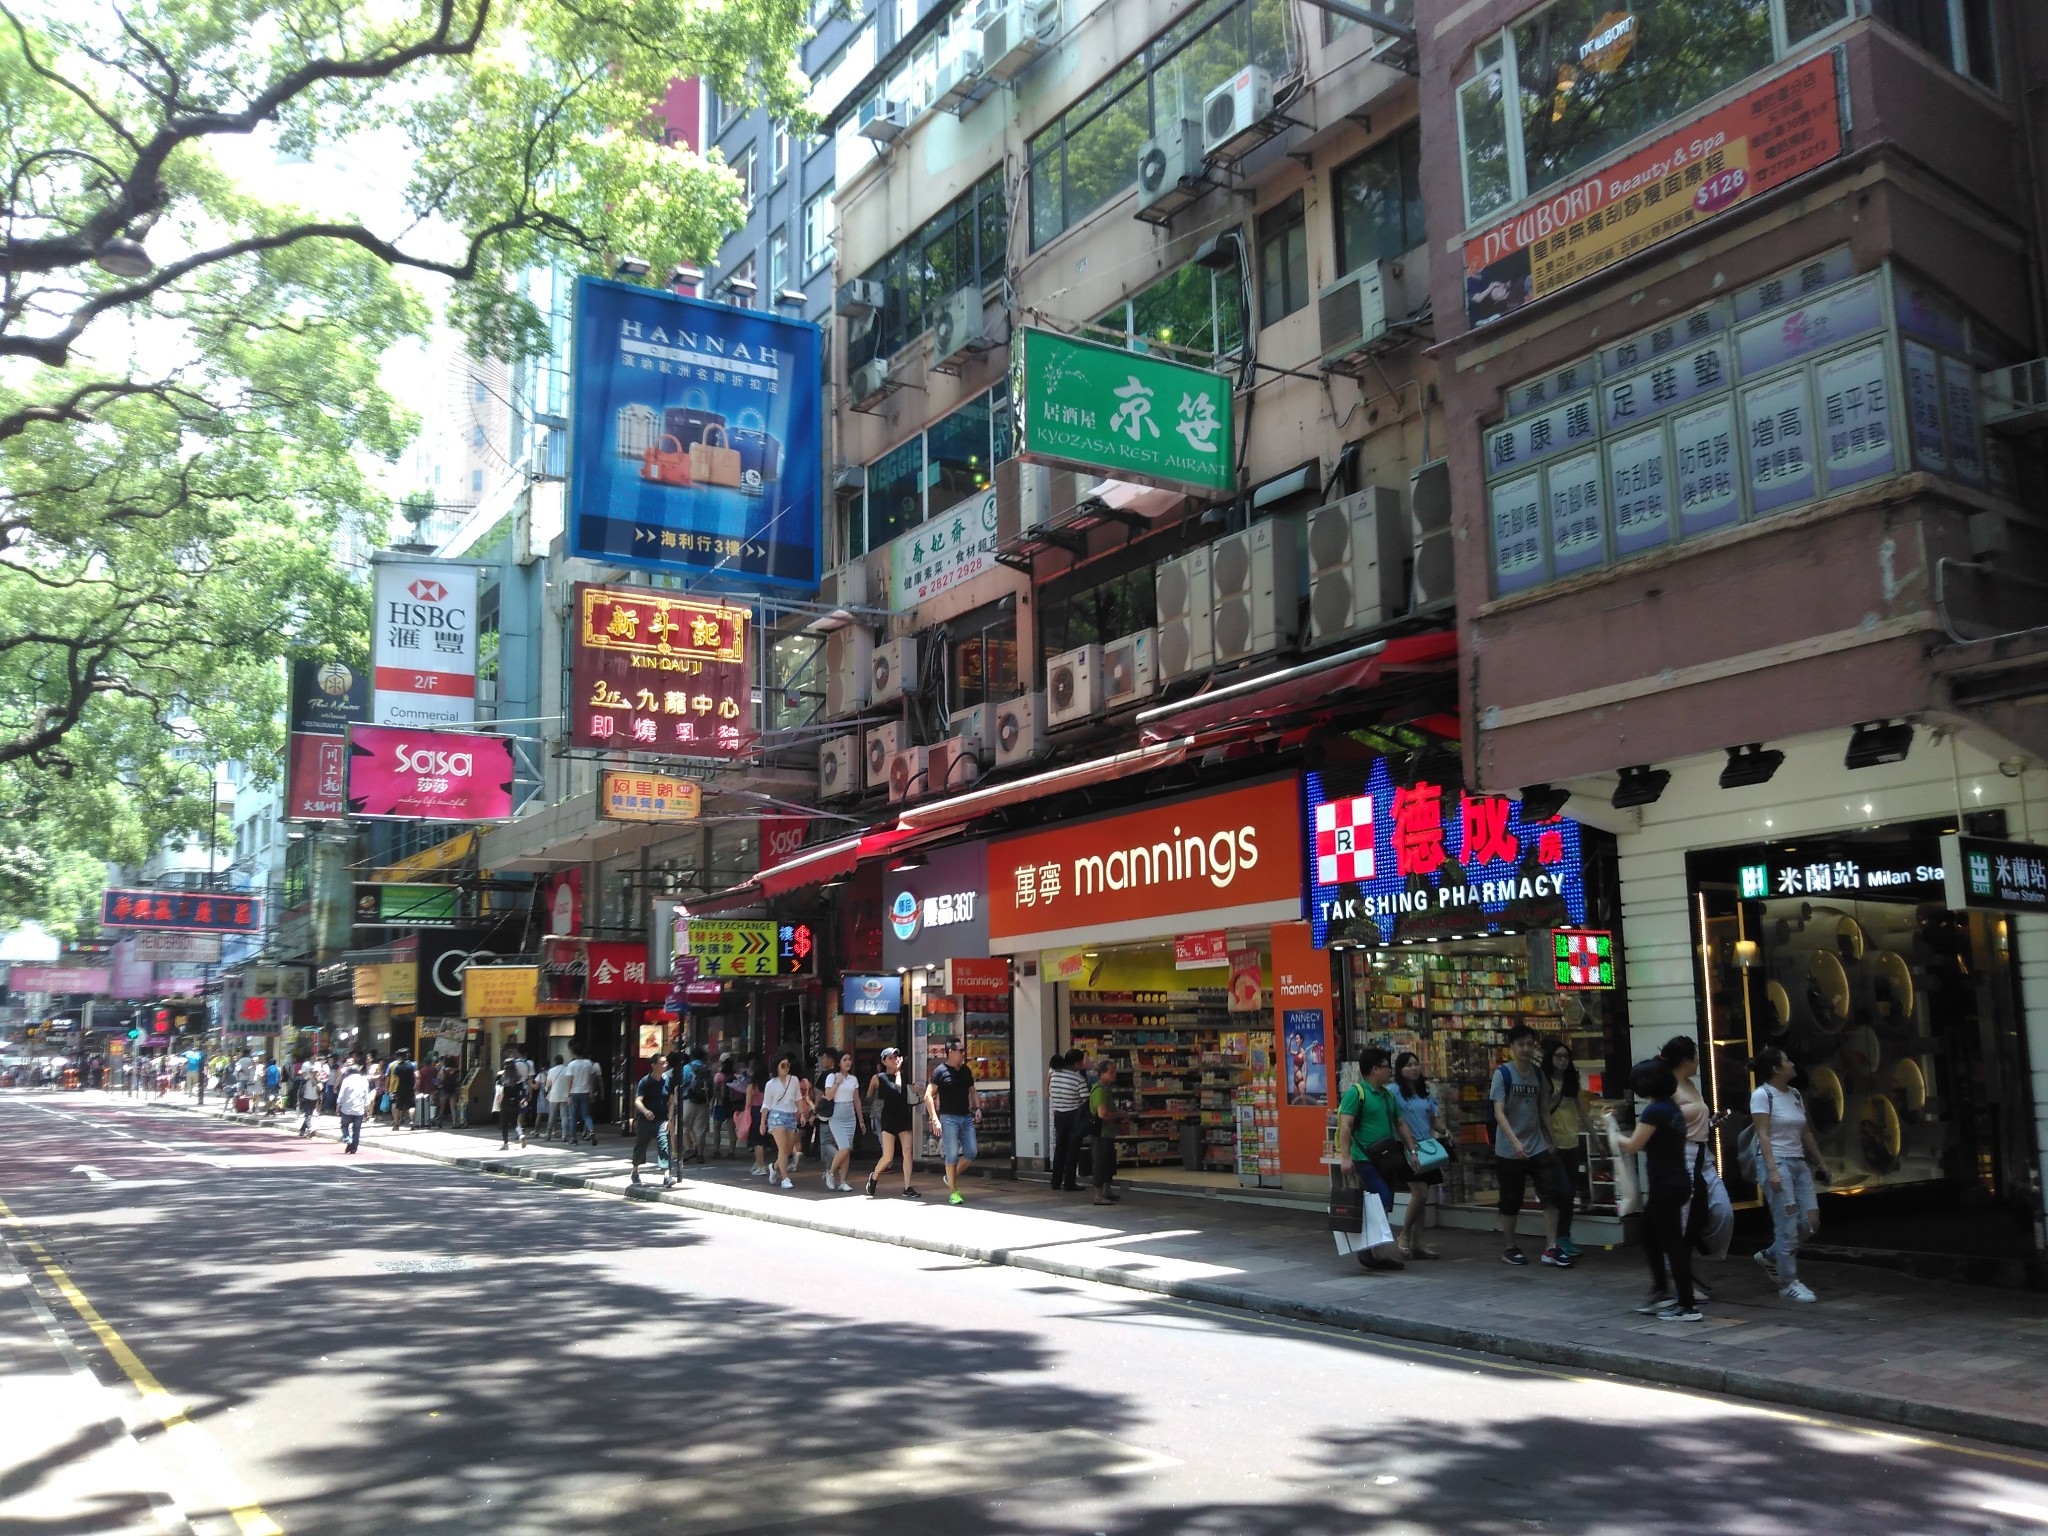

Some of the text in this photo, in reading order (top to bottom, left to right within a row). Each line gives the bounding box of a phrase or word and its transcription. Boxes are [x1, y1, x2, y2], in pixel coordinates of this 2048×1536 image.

[1610, 160, 1671, 200] Beauty
[1673, 147, 1687, 168] &
[1690, 131, 1726, 160] Spa
[1696, 168, 1744, 206] $128
[621, 318, 779, 365] HANNAH
[1044, 400, 1097, 430] 居酒屋
[1826, 379, 1886, 428] 扁平足
[1037, 427, 1116, 454] KYOZASA
[1752, 406, 1802, 448] 增高
[660, 529, 741, 558] 海利行3樓
[931, 557, 982, 592] 2827 2928
[389, 601, 466, 631] HSBC
[606, 605, 722, 647] 新斗記
[630, 655, 702, 676] XIN DAU JI
[413, 675, 438, 690] 2/F
[390, 706, 459, 722] Commercial
[636, 688, 740, 719] 九龍中心
[590, 714, 740, 750] 即燒乳豬
[417, 776, 449, 794] 莎莎
[613, 778, 673, 797] 阿里朗
[423, 796, 437, 808] life
[437, 798, 468, 809] beautiful
[1389, 780, 1518, 877] 德成
[1074, 825, 1258, 896] mannings
[1994, 854, 2047, 890] 米蘭站
[1014, 860, 1061, 909] 萬寧
[1777, 860, 1860, 894] 米蘭站
[1868, 870, 1912, 887] Milan
[1320, 873, 1565, 922] TAK SHING PHARMACY
[1973, 882, 1990, 895] EXIT
[2020, 889, 2046, 903] Station
[690, 921, 772, 931] ONEY EXCHANGE
[592, 957, 645, 985] 金湖
[957, 975, 1003, 988] mannings
[1280, 981, 1324, 997] mannings
[1290, 1012, 1321, 1023] ANNECY
